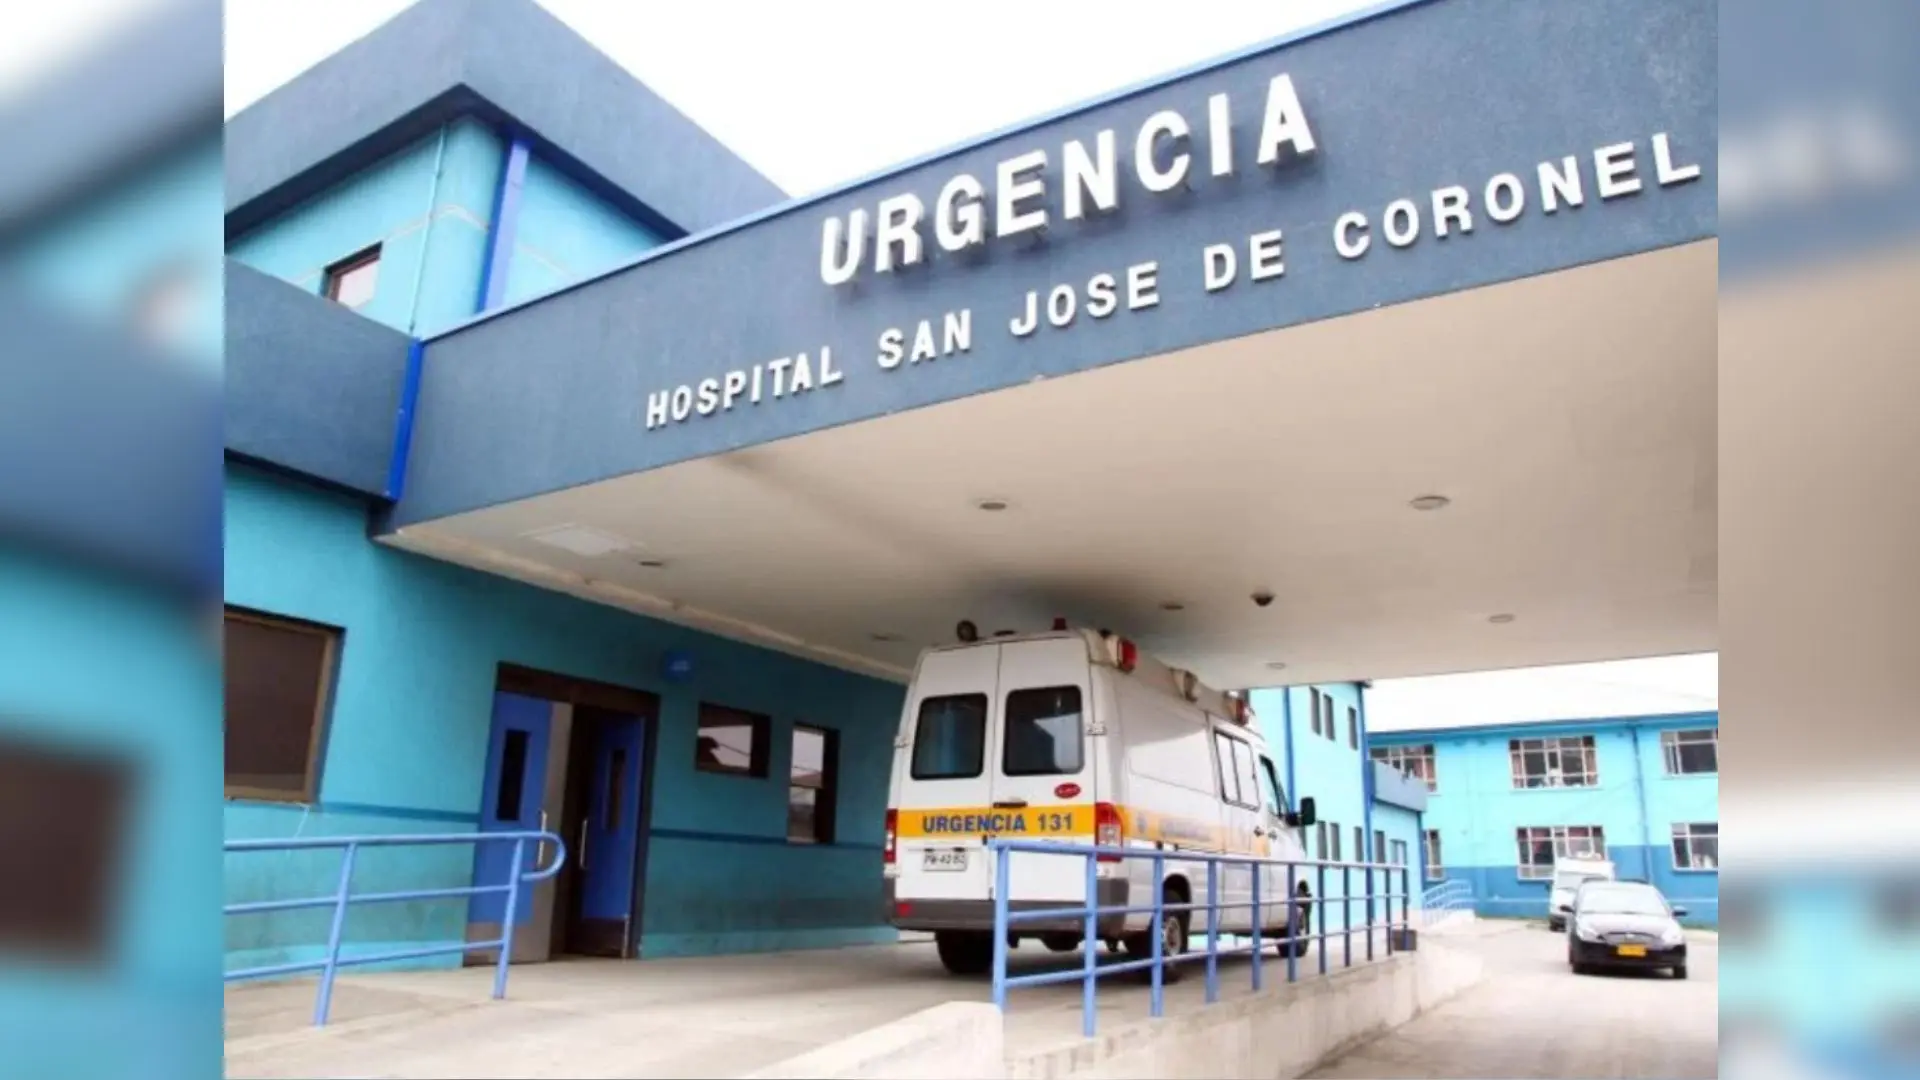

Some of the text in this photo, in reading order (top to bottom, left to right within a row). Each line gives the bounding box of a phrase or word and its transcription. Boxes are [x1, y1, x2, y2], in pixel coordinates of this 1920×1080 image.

[646, 133, 1701, 429] HOSPITAL SAN JOSE DE CORONEL
[819, 73, 1316, 285] URGENCIA
[923, 813, 1073, 833] URGENCIA 131
